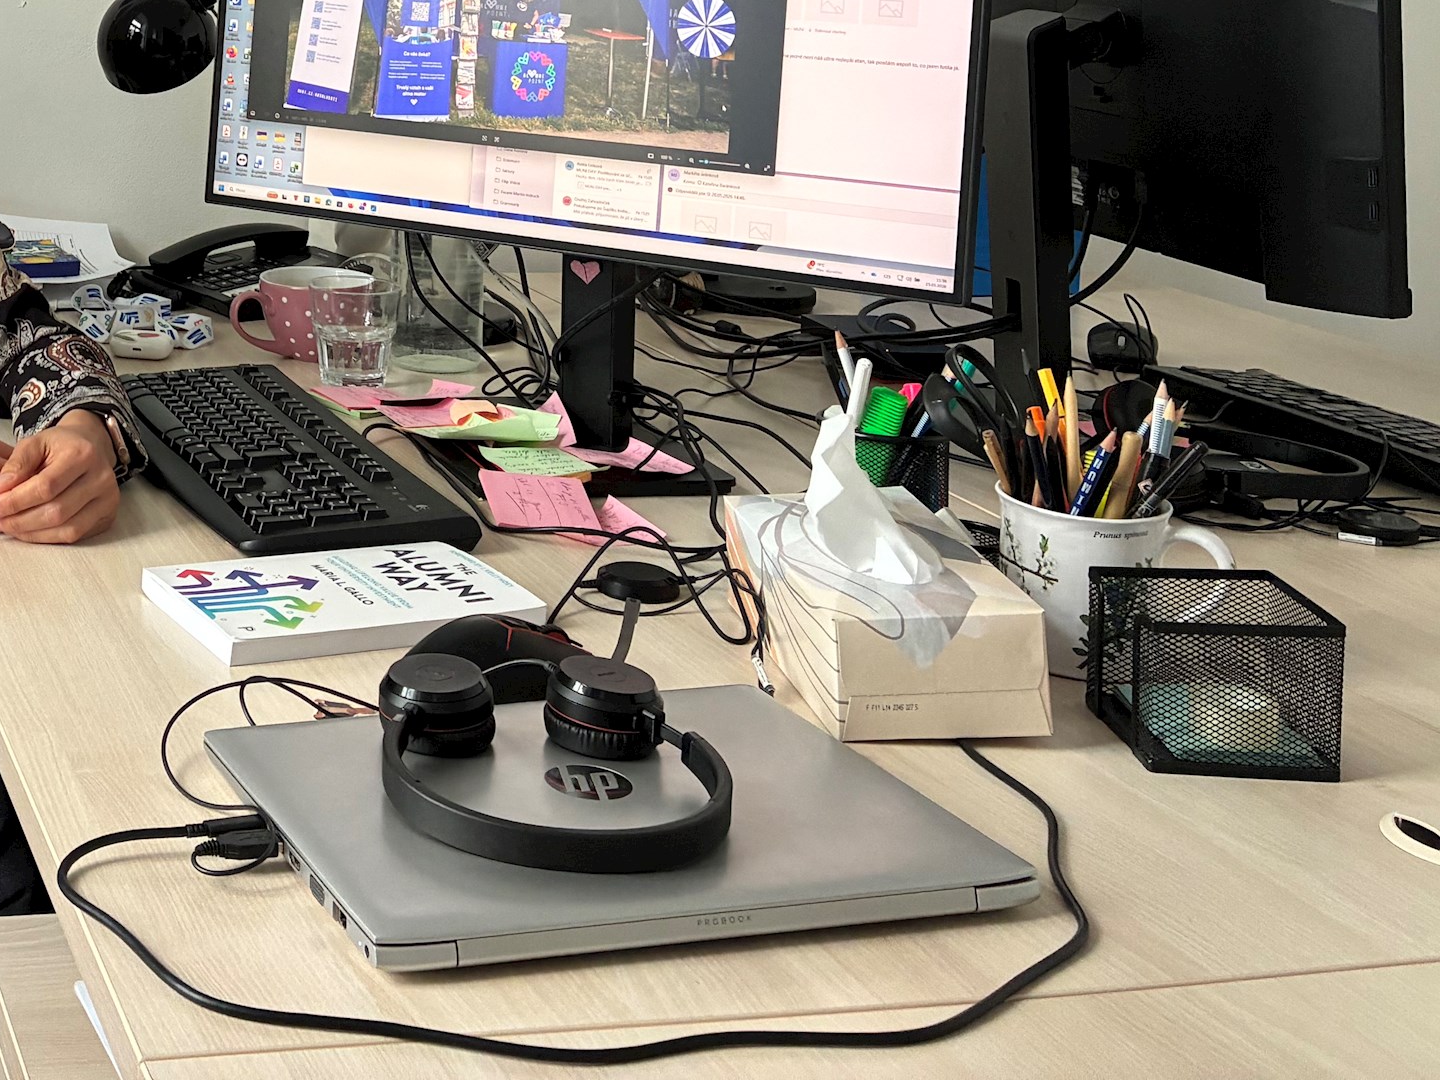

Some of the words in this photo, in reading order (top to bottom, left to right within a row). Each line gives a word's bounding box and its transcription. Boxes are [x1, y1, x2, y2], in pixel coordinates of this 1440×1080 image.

[1093, 531, 1122, 539] Prunus
[311, 563, 337, 583] MARIA
[343, 586, 375, 606] GALLO
[372, 562, 440, 593] WAY
[384, 549, 495, 604] ALUMNI
[452, 563, 479, 576] THE
[558, 764, 620, 802] hp
[696, 915, 754, 927] PROBOOK
